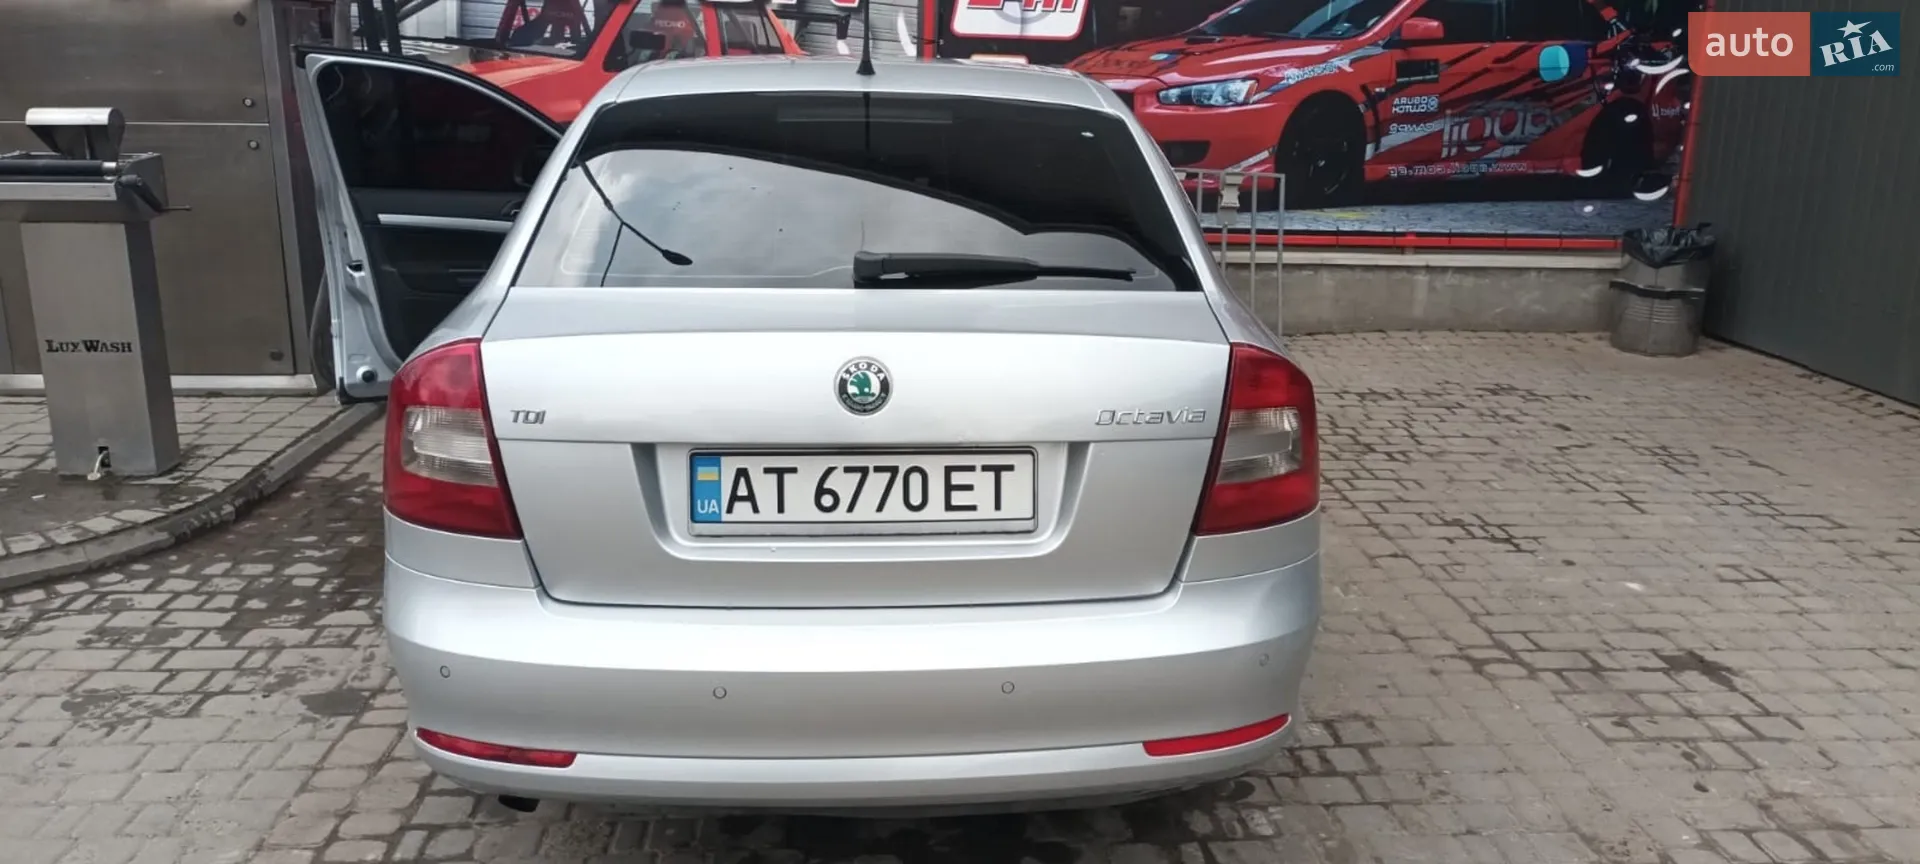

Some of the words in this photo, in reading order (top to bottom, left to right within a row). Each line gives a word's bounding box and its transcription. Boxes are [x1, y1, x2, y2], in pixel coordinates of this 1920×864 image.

[510, 409, 546, 425] TDI
[1095, 406, 1207, 426] Octavia
[725, 466, 798, 514] AT
[813, 465, 929, 513] 6770
[944, 464, 1015, 512] ET
[697, 499, 720, 515] UA
